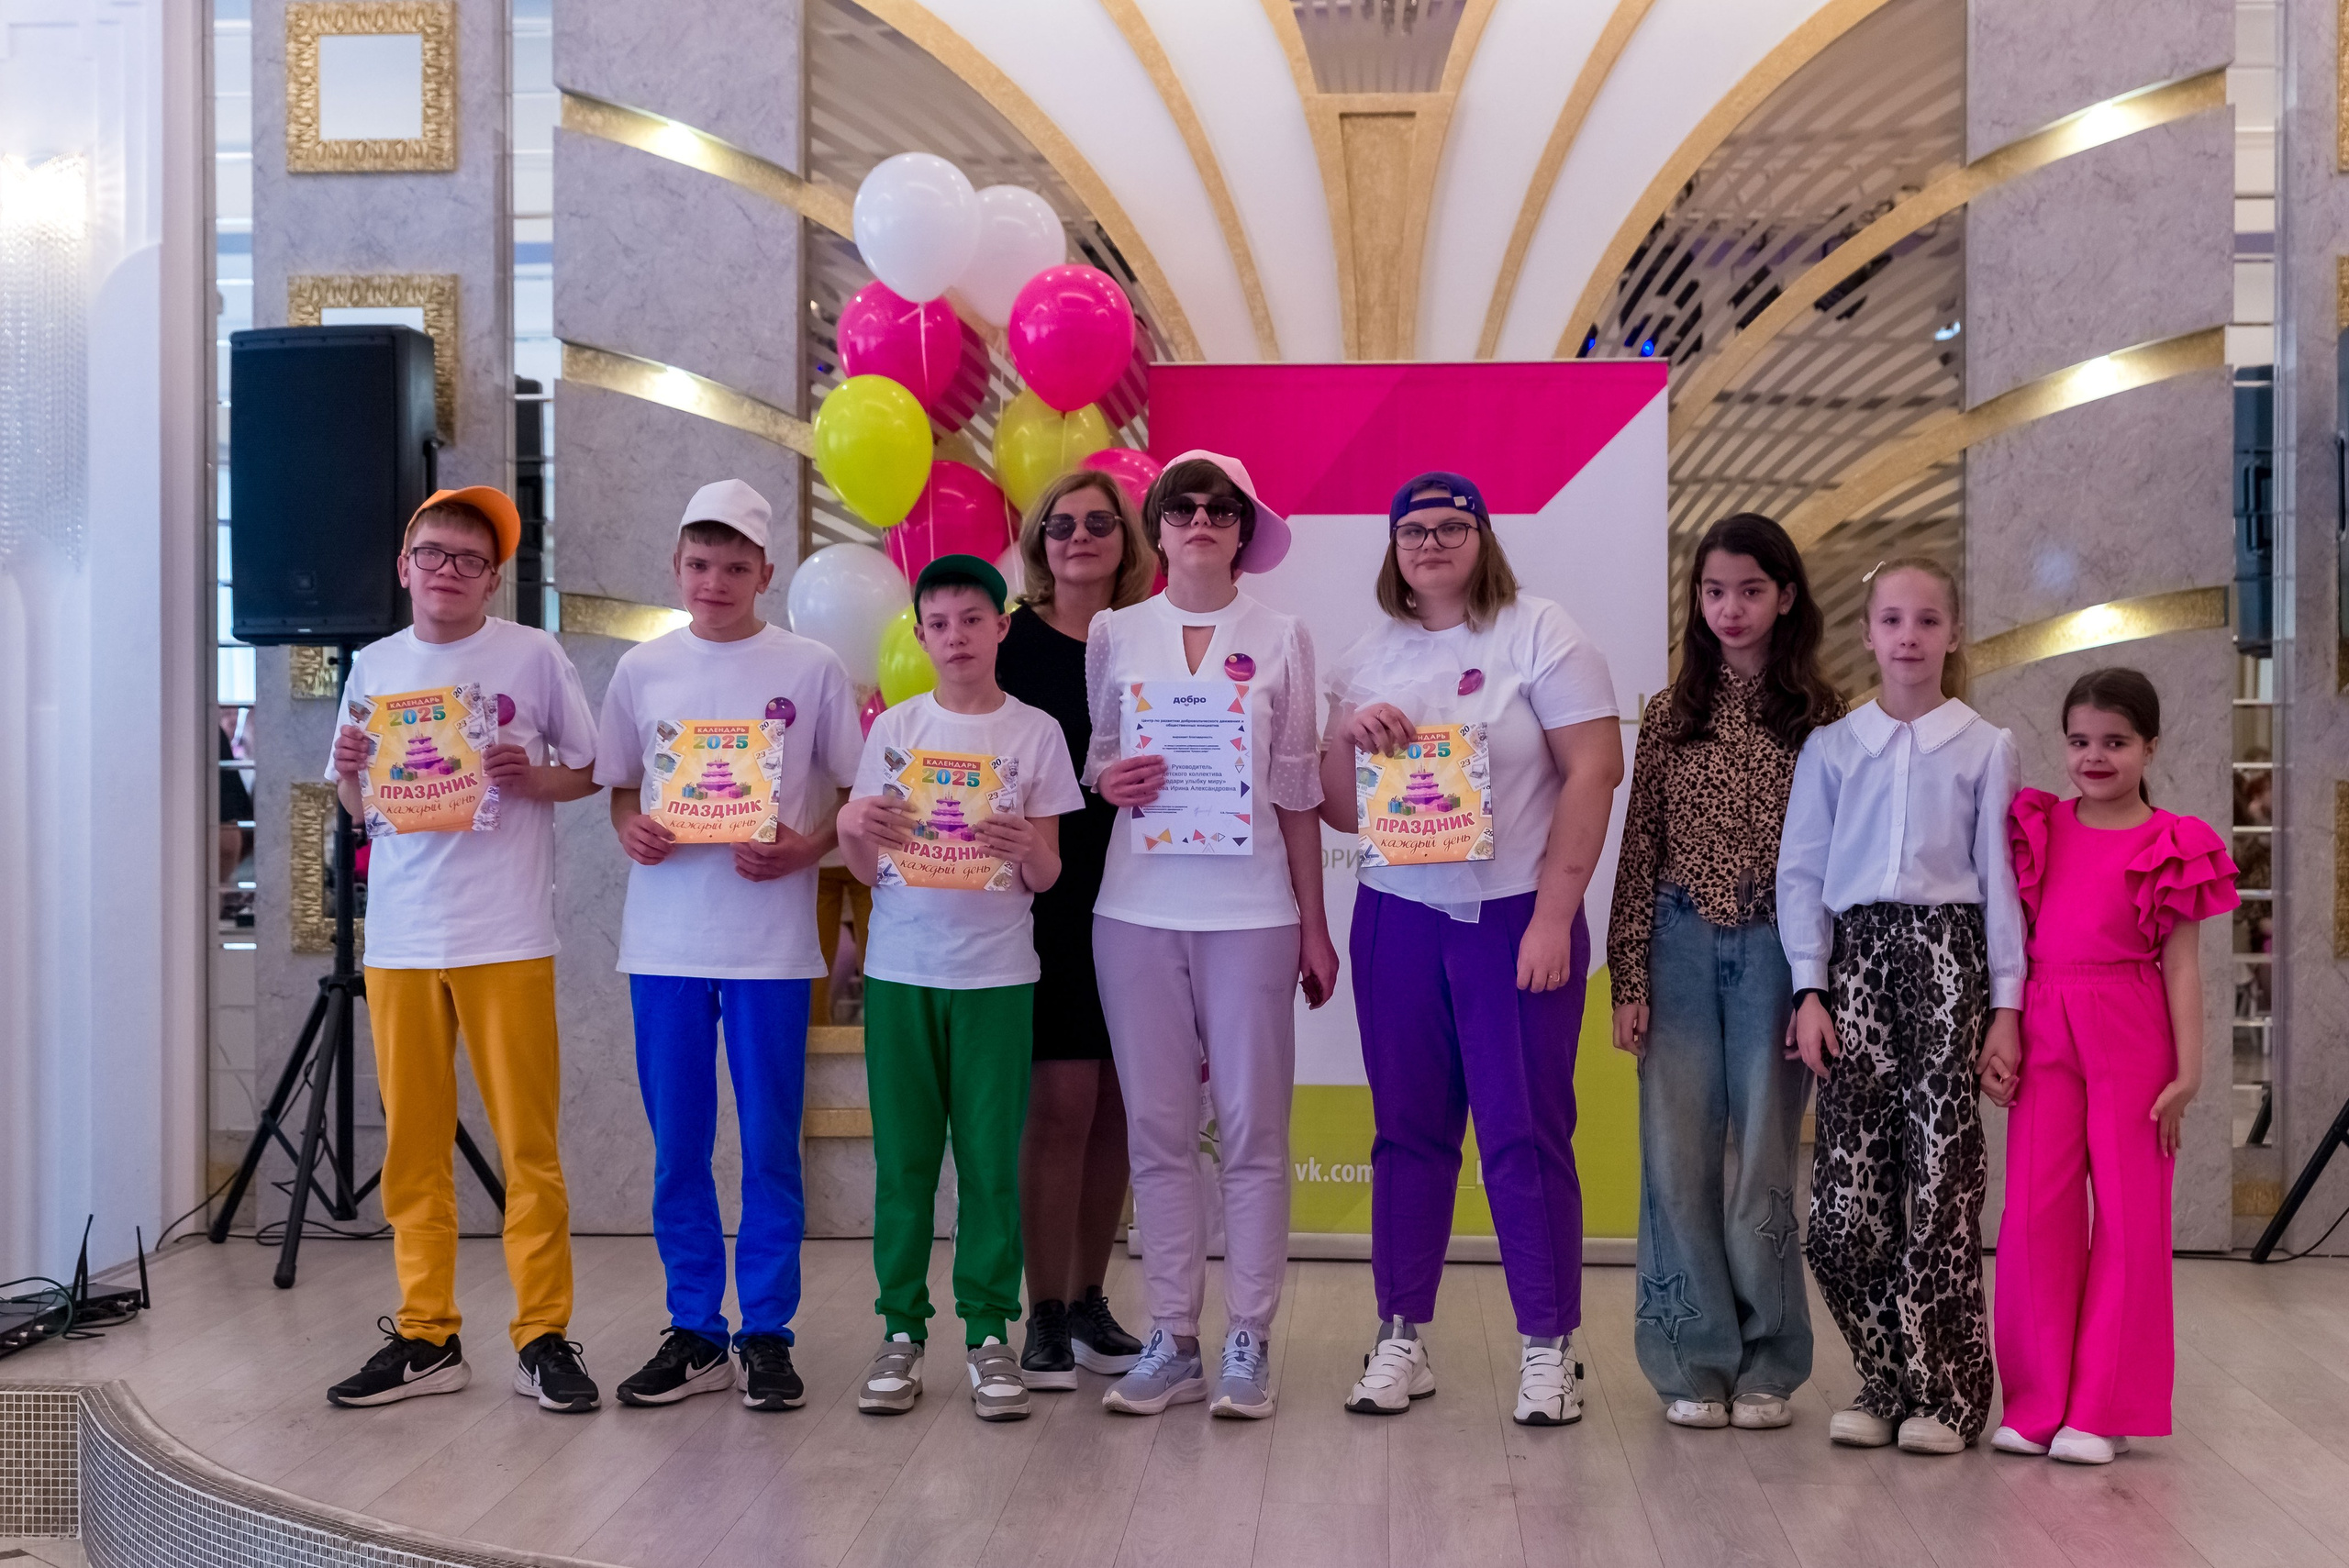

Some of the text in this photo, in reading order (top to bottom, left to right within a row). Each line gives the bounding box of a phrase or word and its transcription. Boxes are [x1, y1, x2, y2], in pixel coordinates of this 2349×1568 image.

[452, 687, 463, 698] 20
[389, 695, 440, 709] КАЛЕНДАРЬ
[1173, 695, 1207, 706] добро
[388, 706, 446, 727] 2025
[456, 719, 467, 729] 23
[760, 721, 770, 731] 20
[1460, 725, 1470, 737] 20
[693, 735, 749, 750] 2025
[1417, 733, 1446, 741] НДАРЬ
[755, 751, 766, 760] 23
[1393, 742, 1452, 760] 2025
[926, 758, 977, 769] КАЛЕНДАРЬ
[992, 758, 1002, 770] 20
[1460, 758, 1471, 768] 23
[921, 768, 980, 787] 2025
[380, 773, 478, 800] ПРАЗДНИК
[988, 792, 998, 800] 23
[386, 795, 476, 817] каждый день
[667, 799, 763, 818] ПРАЗДНИК
[669, 819, 757, 834] каждый день
[1375, 811, 1475, 836] ПРАЗДНИК
[1381, 834, 1471, 854] каждый день
[904, 841, 989, 862] РАЗДНИ
[900, 860, 991, 880] каждый день
